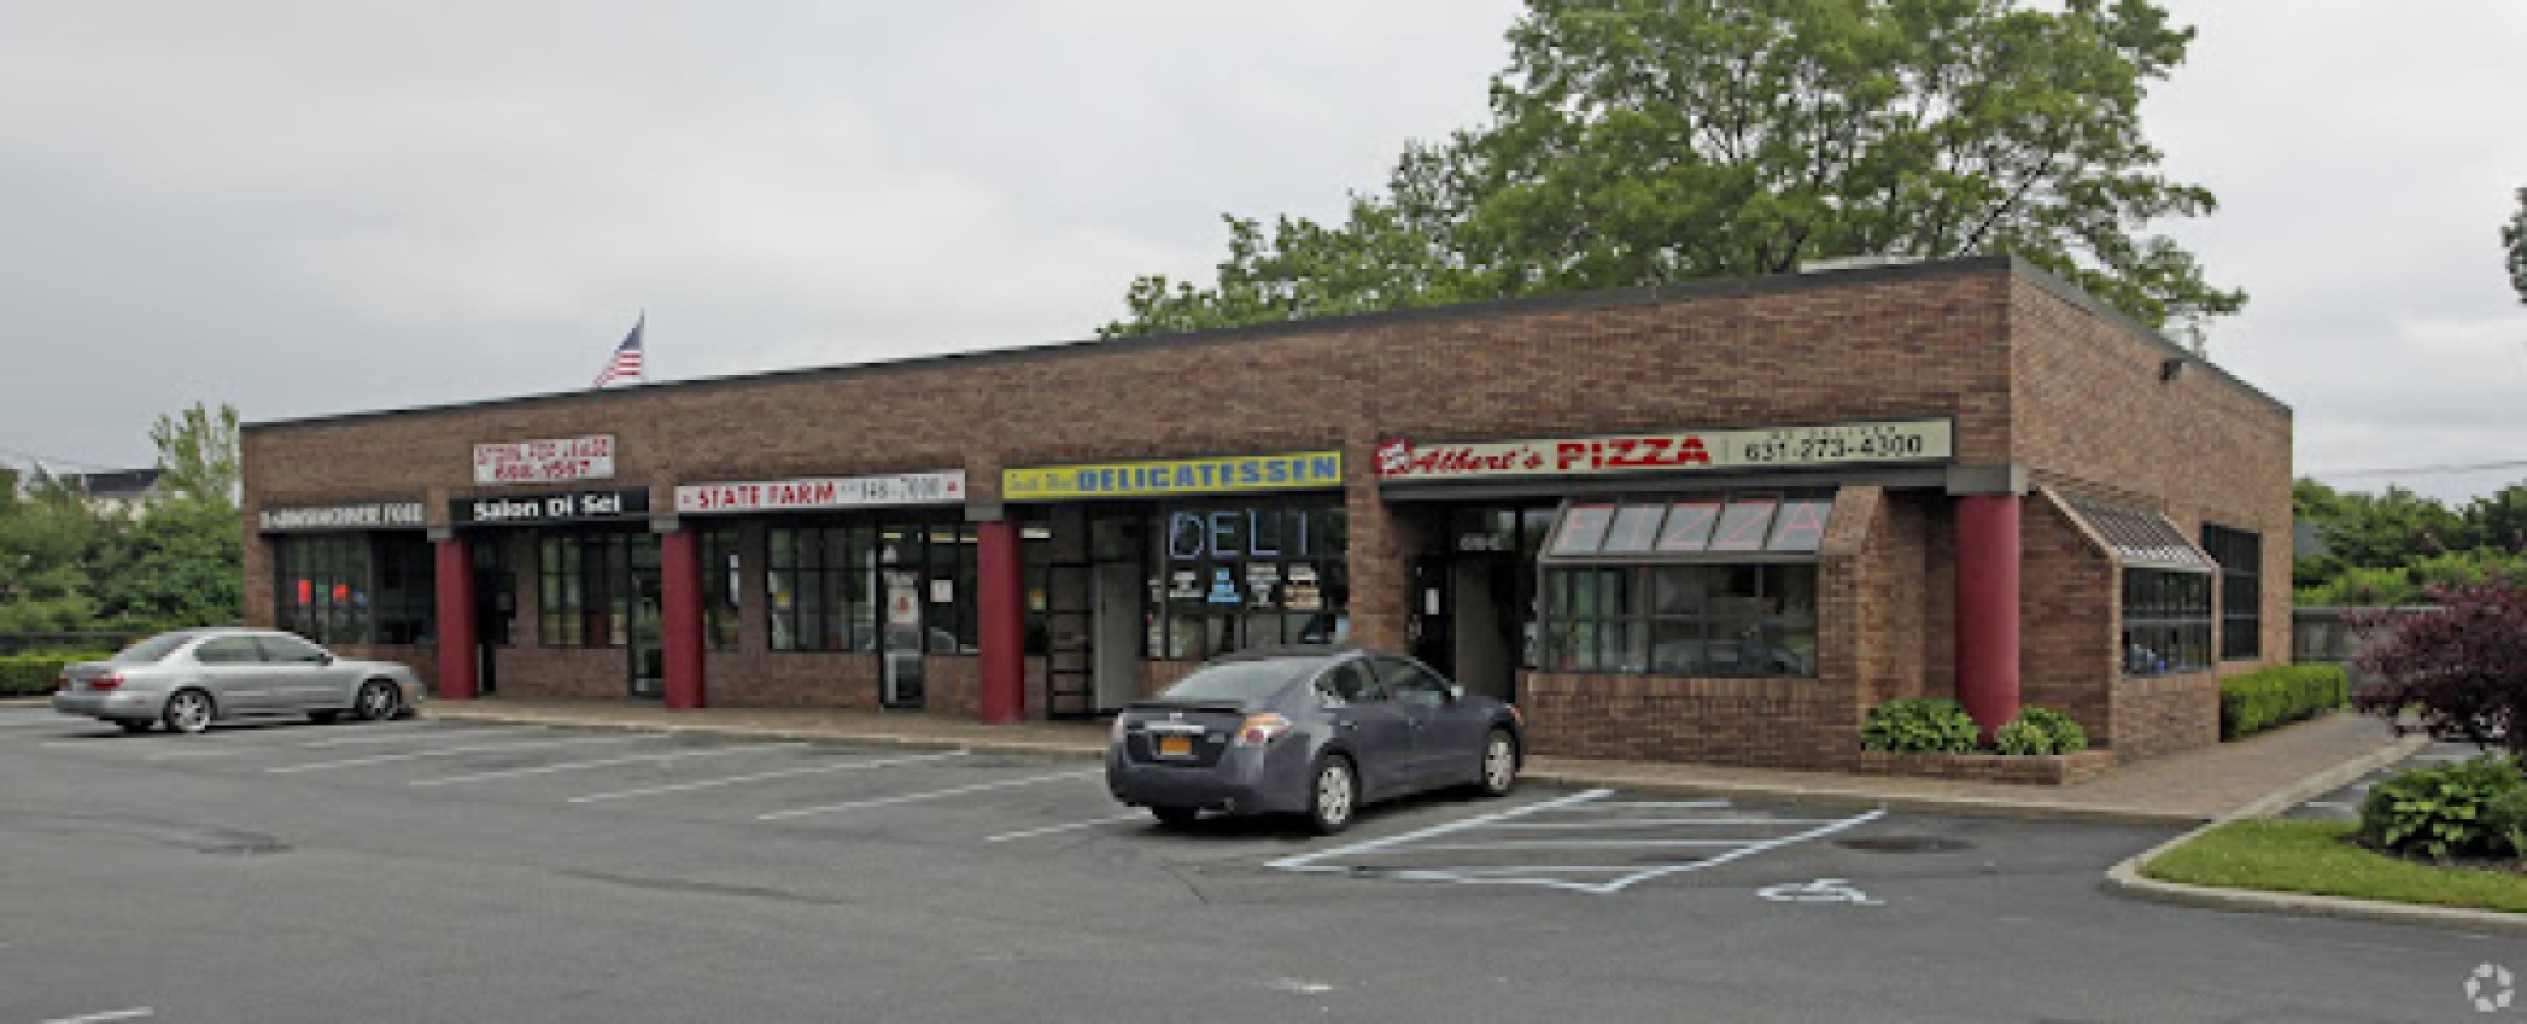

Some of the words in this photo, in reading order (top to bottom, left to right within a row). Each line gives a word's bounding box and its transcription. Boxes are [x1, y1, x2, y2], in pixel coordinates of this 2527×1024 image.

[1411, 444, 1545, 474] Albert's
[1744, 433, 1923, 462] 631-273-4300
[1076, 455, 1337, 493] DELICATESSEN
[473, 499, 540, 522] Salon
[545, 495, 574, 518] Di
[697, 484, 761, 509] STATE
[767, 480, 836, 505] FARM
[1169, 508, 1309, 560] DELI
[1558, 502, 1822, 550] PIZZA
